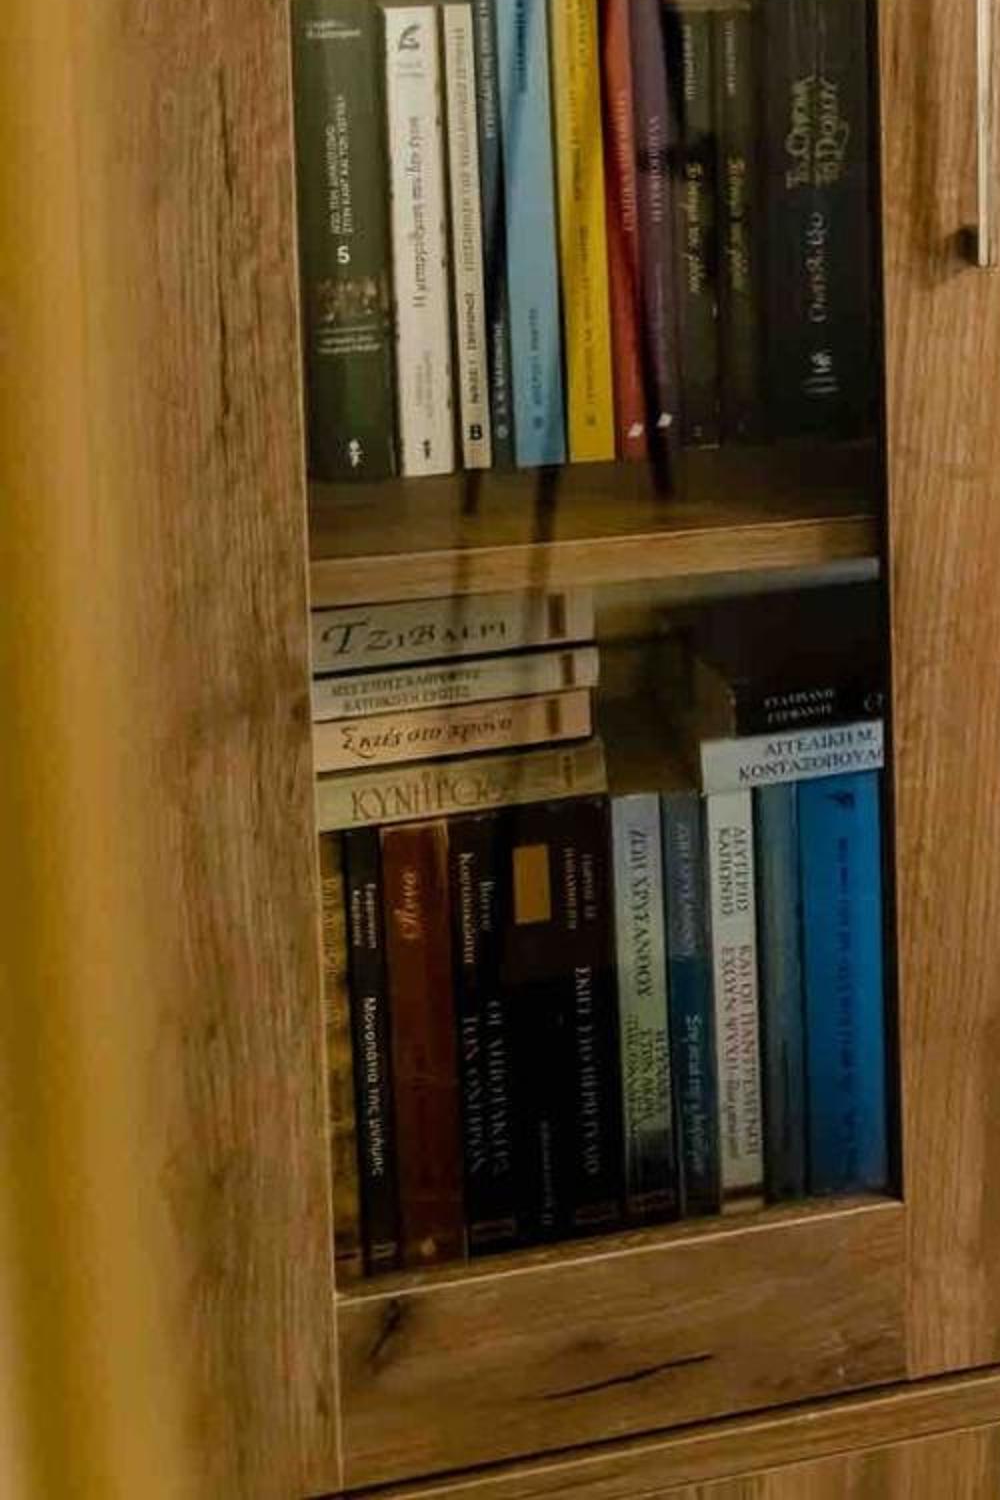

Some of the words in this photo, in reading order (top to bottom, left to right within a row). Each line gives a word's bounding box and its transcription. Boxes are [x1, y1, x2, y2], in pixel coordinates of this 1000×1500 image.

[337, 245, 351, 263] 5
[339, 725, 403, 759] Σκιές
[767, 730, 853, 757] ΑΓΓΕΛΙΚΗ
[718, 827, 735, 916] ΚΑΠΩΝΗΣ
[734, 827, 750, 912] ΛΕΥΤΕΡΗΣ
[633, 875, 654, 997] ΧΡΥΣΑΝΘΟΥ
[722, 947, 737, 1012] ΕΧΟΥΝ
[740, 945, 754, 978] ΚΑΙ
[741, 983, 755, 1005] ΟΙ
[363, 996, 381, 1083] Μονοπάτια
[367, 1087, 383, 1116] της
[367, 1117, 384, 1178] μνήμης
